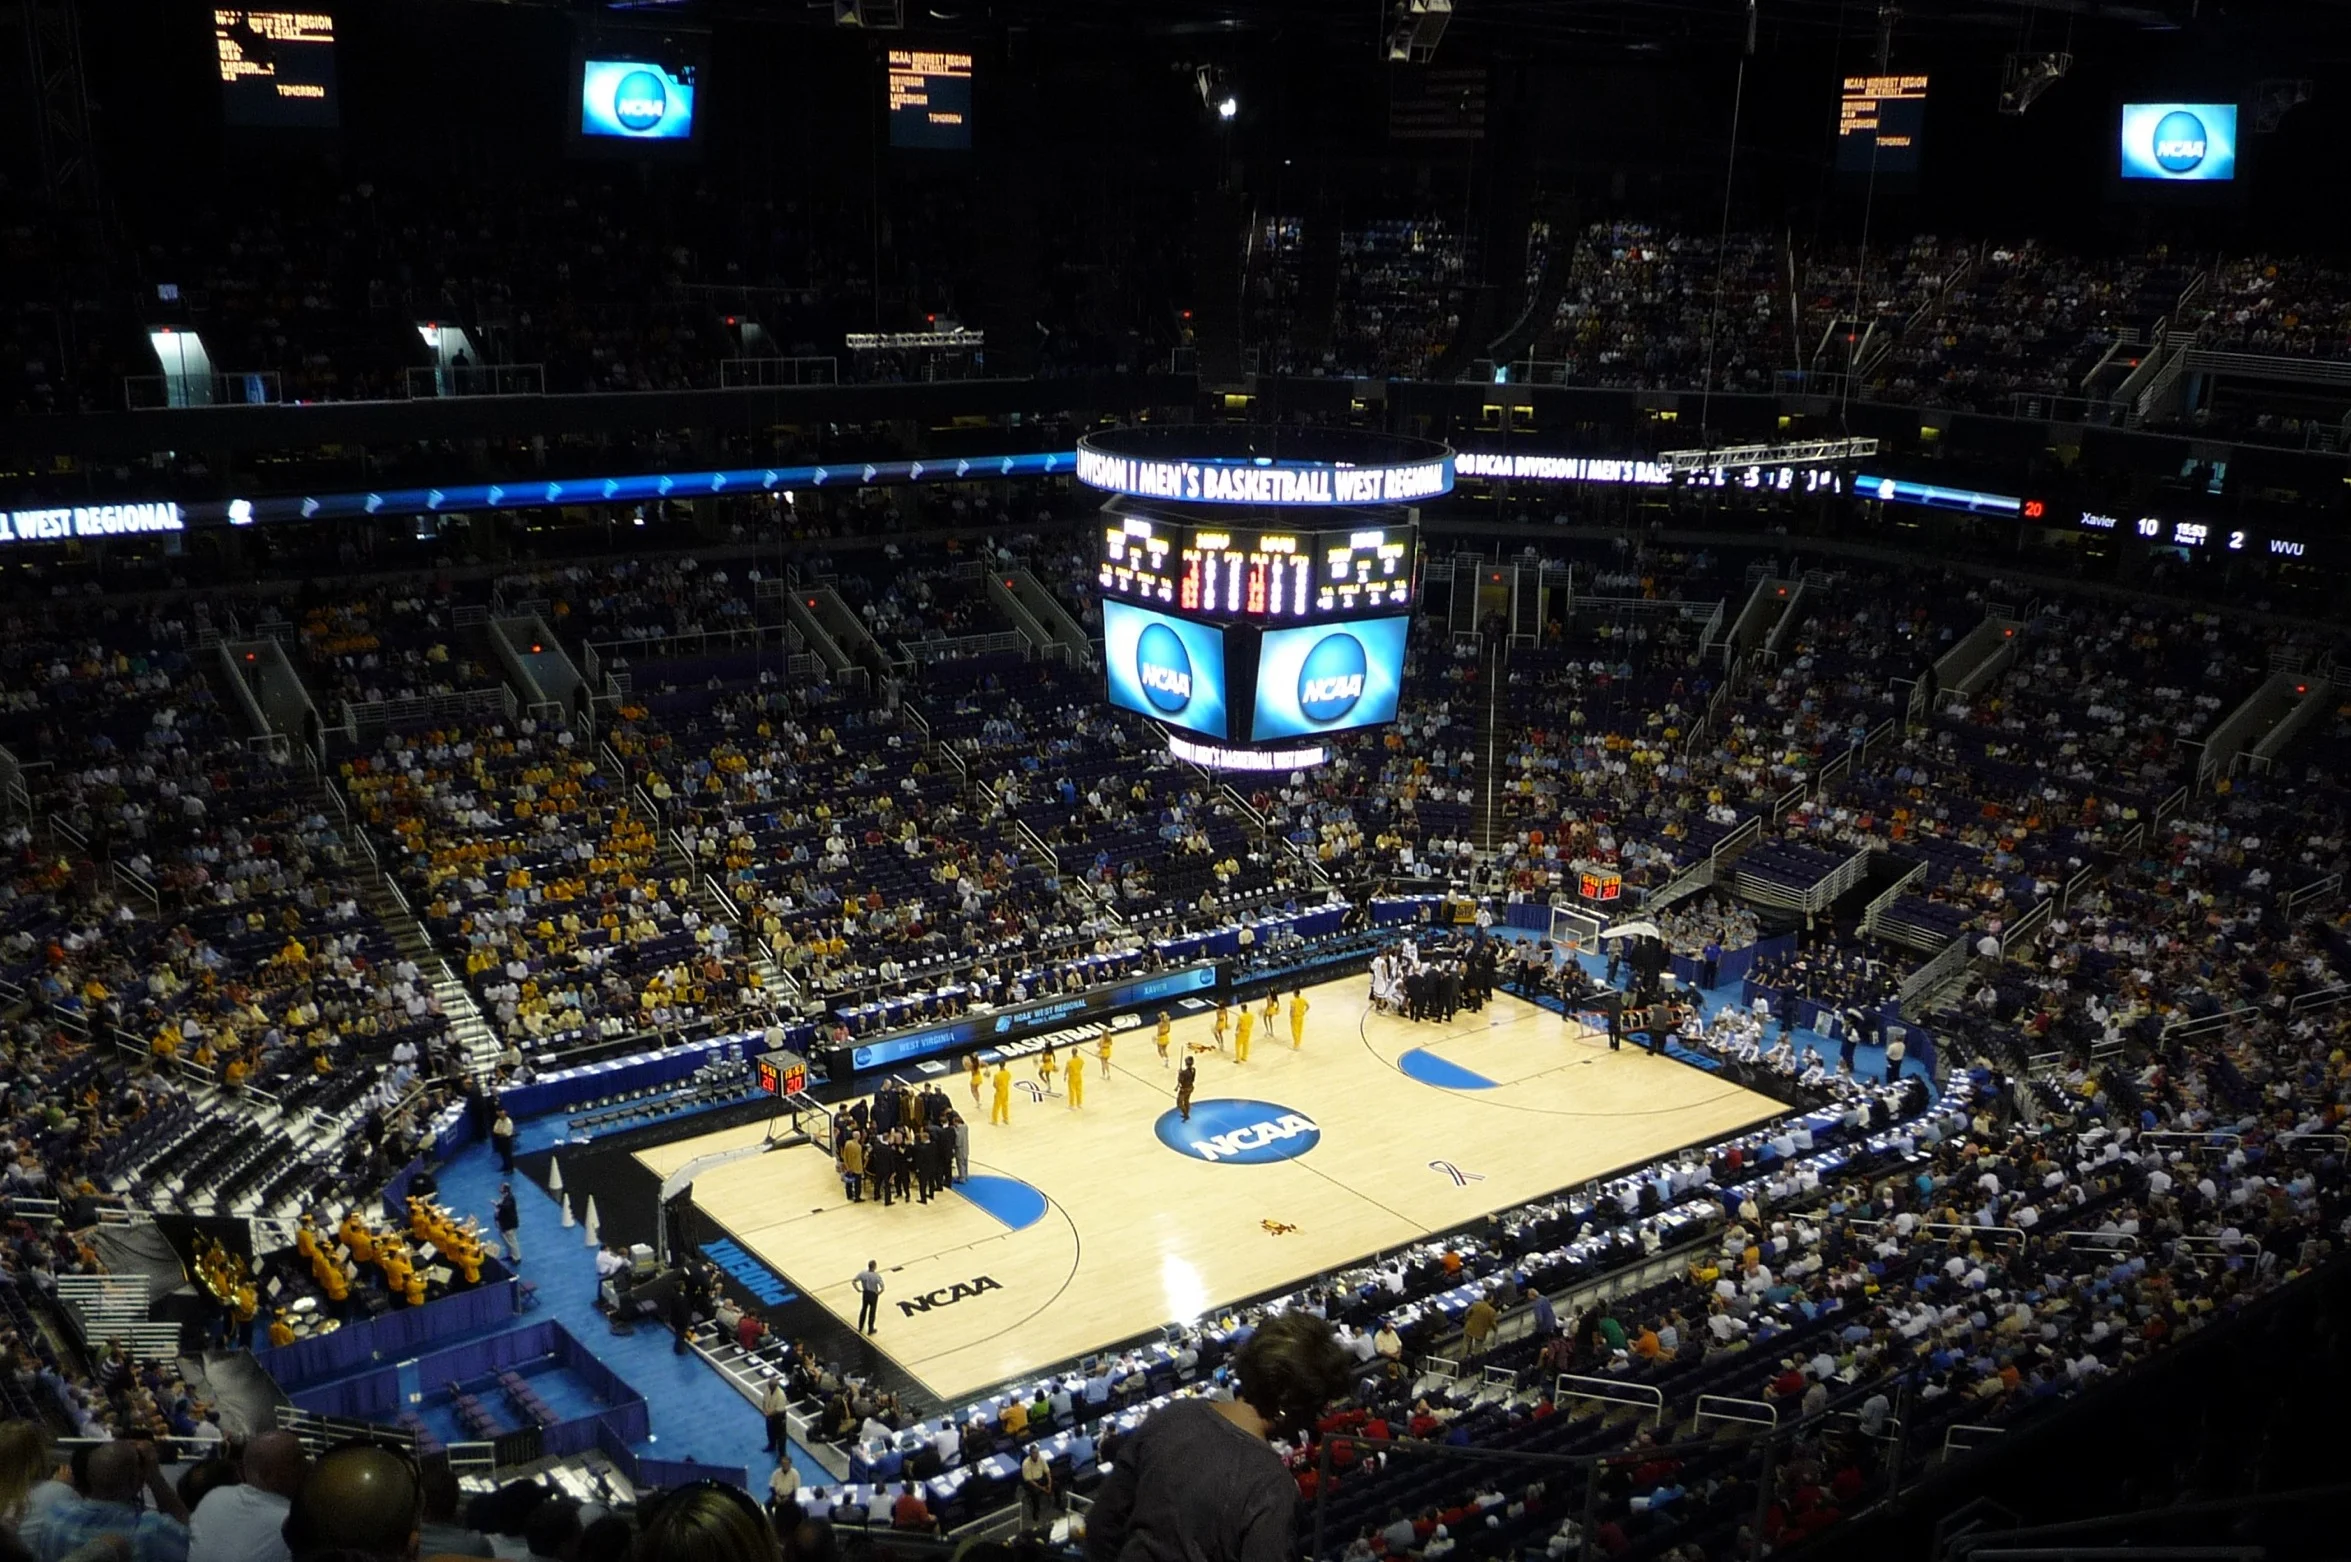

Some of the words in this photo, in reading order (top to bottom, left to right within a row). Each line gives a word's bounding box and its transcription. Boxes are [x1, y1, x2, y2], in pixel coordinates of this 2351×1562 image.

[295, 14, 333, 30] REGION
[946, 54, 971, 67] REGION
[277, 84, 324, 97] TOMORROW
[1900, 76, 1928, 88] REGION
[618, 98, 664, 117] NCAA
[2157, 140, 2204, 158] NCAA
[1475, 454, 1513, 477] NCAA
[1515, 456, 1578, 479] DIVISION
[1587, 459, 1634, 482] MEN'S
[1139, 462, 1200, 499] MEN'S
[1204, 467, 1332, 502] BASKETBALL
[1334, 469, 1384, 502] WEST
[1384, 463, 1444, 500] REGIONAL
[2024, 501, 2043, 517] 20
[13, 509, 72, 540] WEST
[73, 502, 184, 536] REGIONAL
[2081, 511, 2117, 529] Xavier
[2138, 518, 2159, 536] 10
[2229, 531, 2244, 550] 2
[2270, 539, 2305, 557] WVU
[1142, 662, 1191, 699] NCAA
[1302, 674, 1362, 704] NCAA
[1603, 886, 1617, 899] 20
[1143, 982, 1168, 995] XAVIER
[1013, 1012, 1032, 1023] NCAA
[1034, 1006, 1054, 1017] WEST
[1054, 998, 1087, 1013] REGIONAL
[899, 1042, 920, 1053] WEST
[921, 1032, 955, 1048] VIRGINIA
[995, 1022, 1117, 1057] BASKETBALL
[787, 1076, 802, 1094] 20
[1190, 1114, 1320, 1161] NCAA
[699, 1237, 799, 1307] PHOENIX
[896, 1275, 1004, 1318] NCAA
